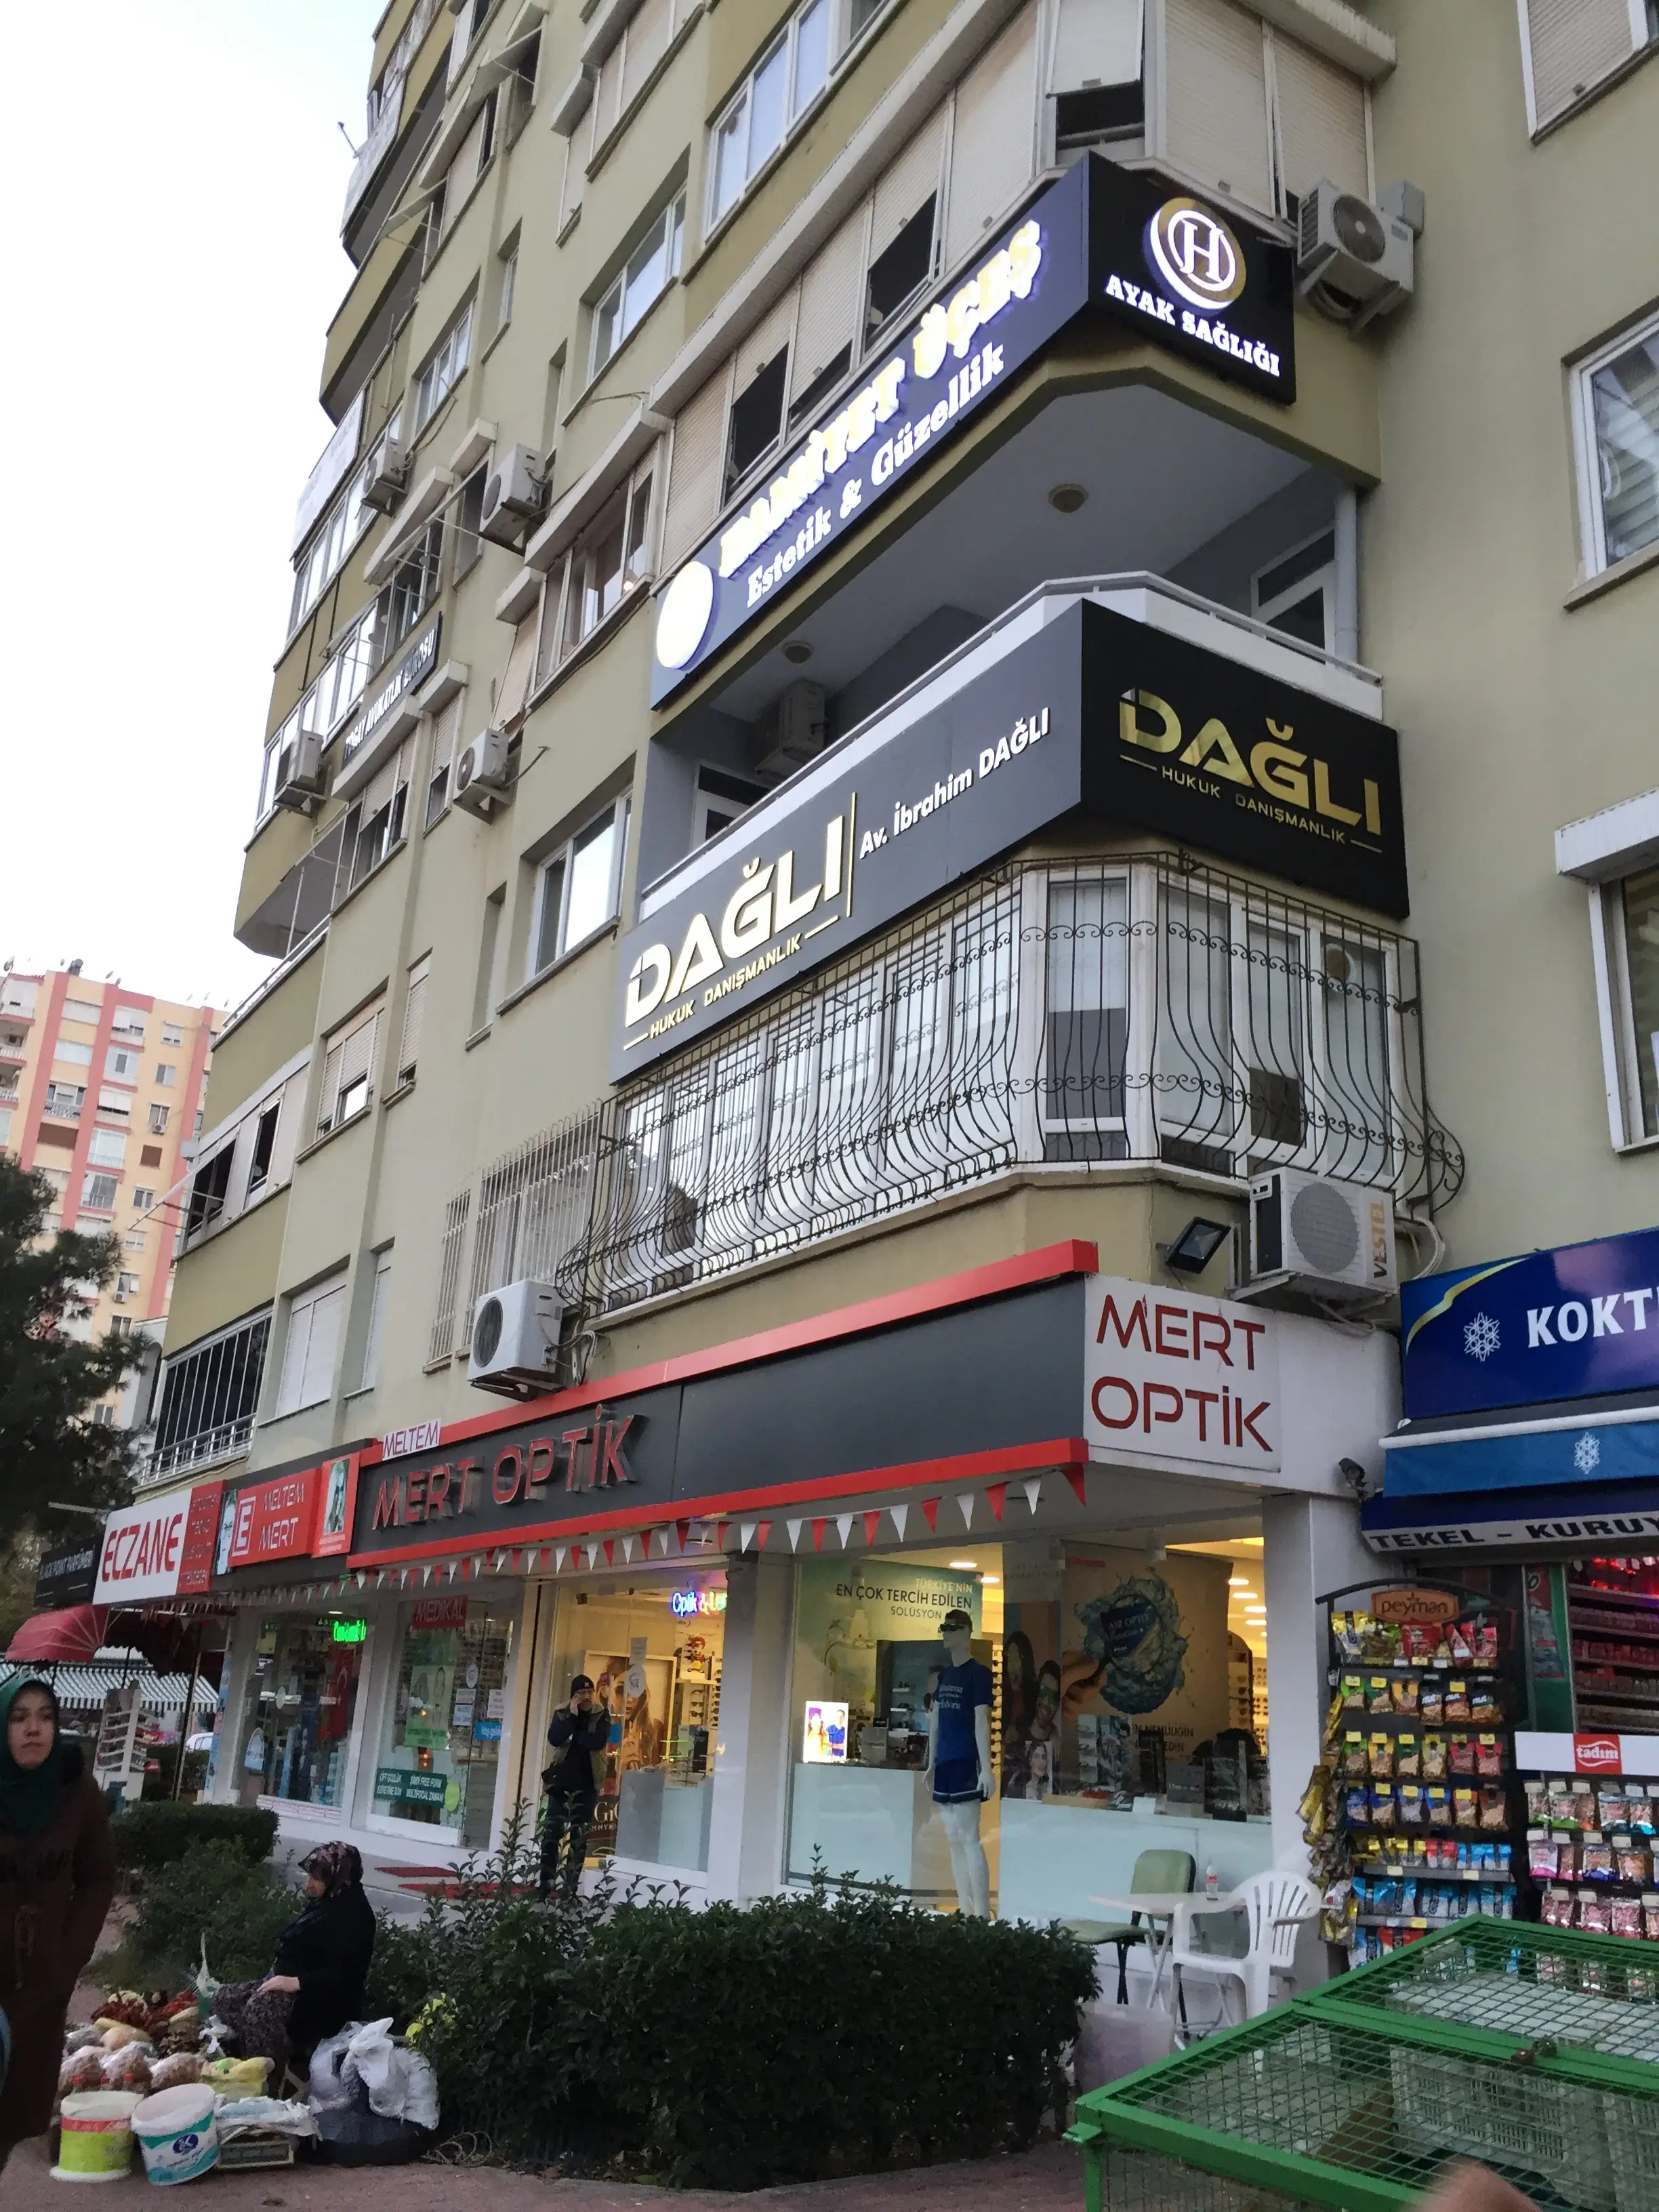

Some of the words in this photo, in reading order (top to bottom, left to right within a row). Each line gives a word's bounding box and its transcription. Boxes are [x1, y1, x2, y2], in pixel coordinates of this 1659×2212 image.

[1105, 274, 1176, 326] AYAK
[1182, 310, 1280, 377] SAĞLIĞI
[747, 505, 832, 608] Estetik
[840, 479, 862, 519] &
[872, 342, 1004, 485] Güzellik
[859, 828, 887, 859] Av.
[894, 768, 972, 836] İbrahim
[979, 708, 1049, 779] DAĞLI
[1119, 687, 1381, 836] DAĞLI
[1162, 766, 1221, 798] HUKUK
[1235, 792, 1346, 844] DANIŞMANLIK
[626, 815, 844, 1027] DAĞLI
[649, 1000, 695, 1039] HUKUK
[703, 933, 802, 1007] DANIŞMANLIK
[1370, 1201, 1387, 1278] VESTEL
[1096, 1294, 1265, 1371] MERT
[1526, 1286, 1659, 1349] KOKT
[383, 1420, 441, 1458] MELTEM
[1091, 1376, 1273, 1452] OPTİK
[262, 1482, 304, 1512] MELTEM
[371, 1457, 476, 1530] MERT
[492, 1404, 635, 1505] OPTİK
[101, 1513, 184, 1582] ECZANE
[258, 1517, 300, 1551] MERT
[1370, 1529, 1485, 1549] TEKEL
[836, 1583, 853, 1597] EN
[856, 1586, 883, 1601] ÇOK
[887, 1589, 928, 1605] TERCİH
[932, 1593, 972, 1609] EDİLEN
[1381, 1599, 1448, 1616] peyman
[1576, 1746, 1619, 1760] tadım
